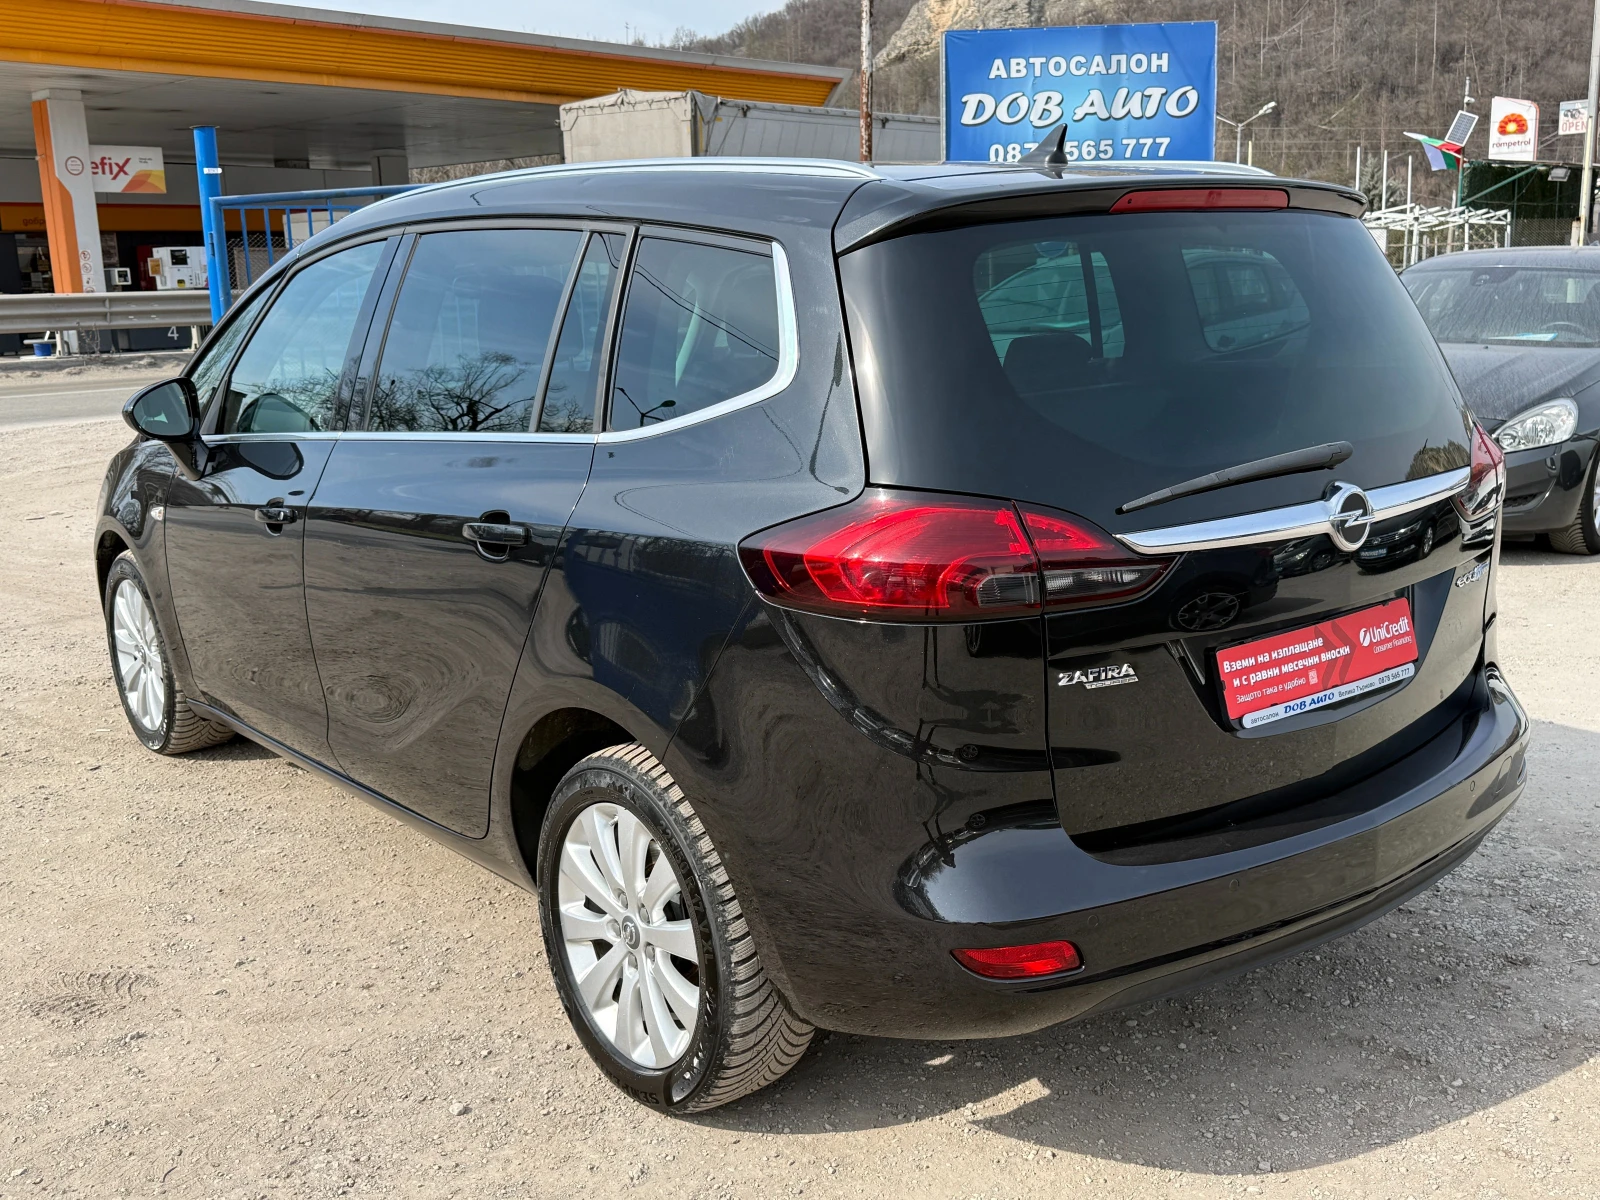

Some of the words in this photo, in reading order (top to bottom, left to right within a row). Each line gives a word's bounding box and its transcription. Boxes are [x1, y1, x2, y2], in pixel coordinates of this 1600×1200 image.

[988, 52, 1169, 79] АВТОСАЛОН
[960, 90, 1064, 127] DOB
[1072, 85, 1199, 121] AUTO
[989, 142, 1040, 162] 087
[1064, 139, 1114, 161] 565
[1122, 137, 1171, 158] 777
[1492, 139, 1531, 149] rompetrol
[167, 326, 179, 341] 4
[1370, 616, 1410, 643] UniCredit
[1223, 656, 1256, 673] Вземи
[1257, 652, 1270, 664] на
[1271, 637, 1324, 660] изплащане
[1233, 677, 1241, 688] и
[1242, 675, 1248, 685] с
[1249, 666, 1280, 686] равни
[1281, 655, 1320, 674] месечни
[1320, 645, 1351, 662] вноски
[1057, 663, 1136, 686] ZAFIRA
[1378, 674, 1391, 685] 0878
[1391, 671, 1401, 680] 565
[1401, 667, 1410, 677] 777
[1236, 690, 1262, 704] Защото
[1262, 686, 1278, 696] така
[1283, 677, 1307, 692] удобно
[1284, 700, 1307, 714] DOB
[1308, 691, 1335, 707] AUTO
[1337, 687, 1356, 698] Велико
[1250, 711, 1280, 725] автосалон
